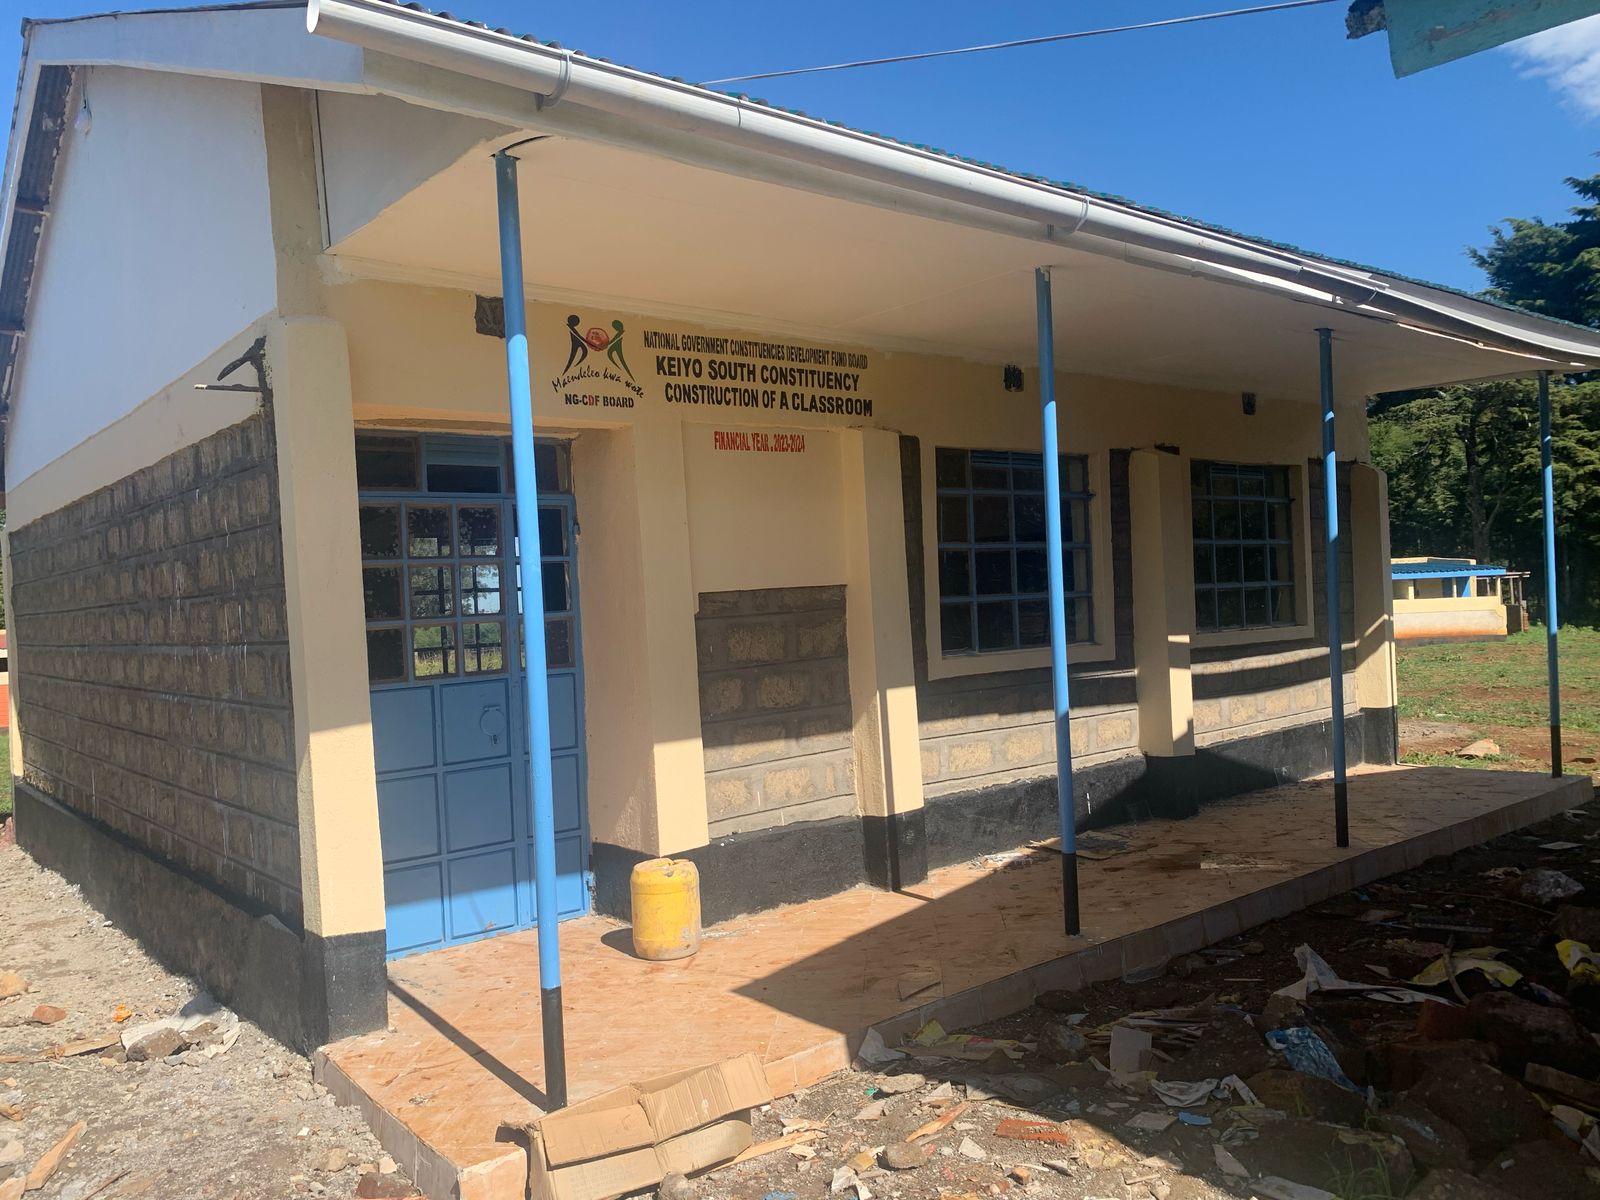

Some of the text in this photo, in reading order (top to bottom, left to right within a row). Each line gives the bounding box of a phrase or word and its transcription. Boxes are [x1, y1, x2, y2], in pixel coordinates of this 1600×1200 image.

[643, 330, 869, 370] NATIONAL GOVERNMENT CONSTITUENCIES DEVELOPMENT FUND BOARD
[602, 367, 622, 383] kwa
[624, 379, 645, 399] wote
[655, 355, 861, 392] KEIYO SOUTH CONSTITUENCY
[564, 393, 635, 409] NG-CDF BOARD
[664, 382, 873, 417] CONSTRUCTION OF A CLASSROOM
[713, 430, 751, 451] FINANCIAL
